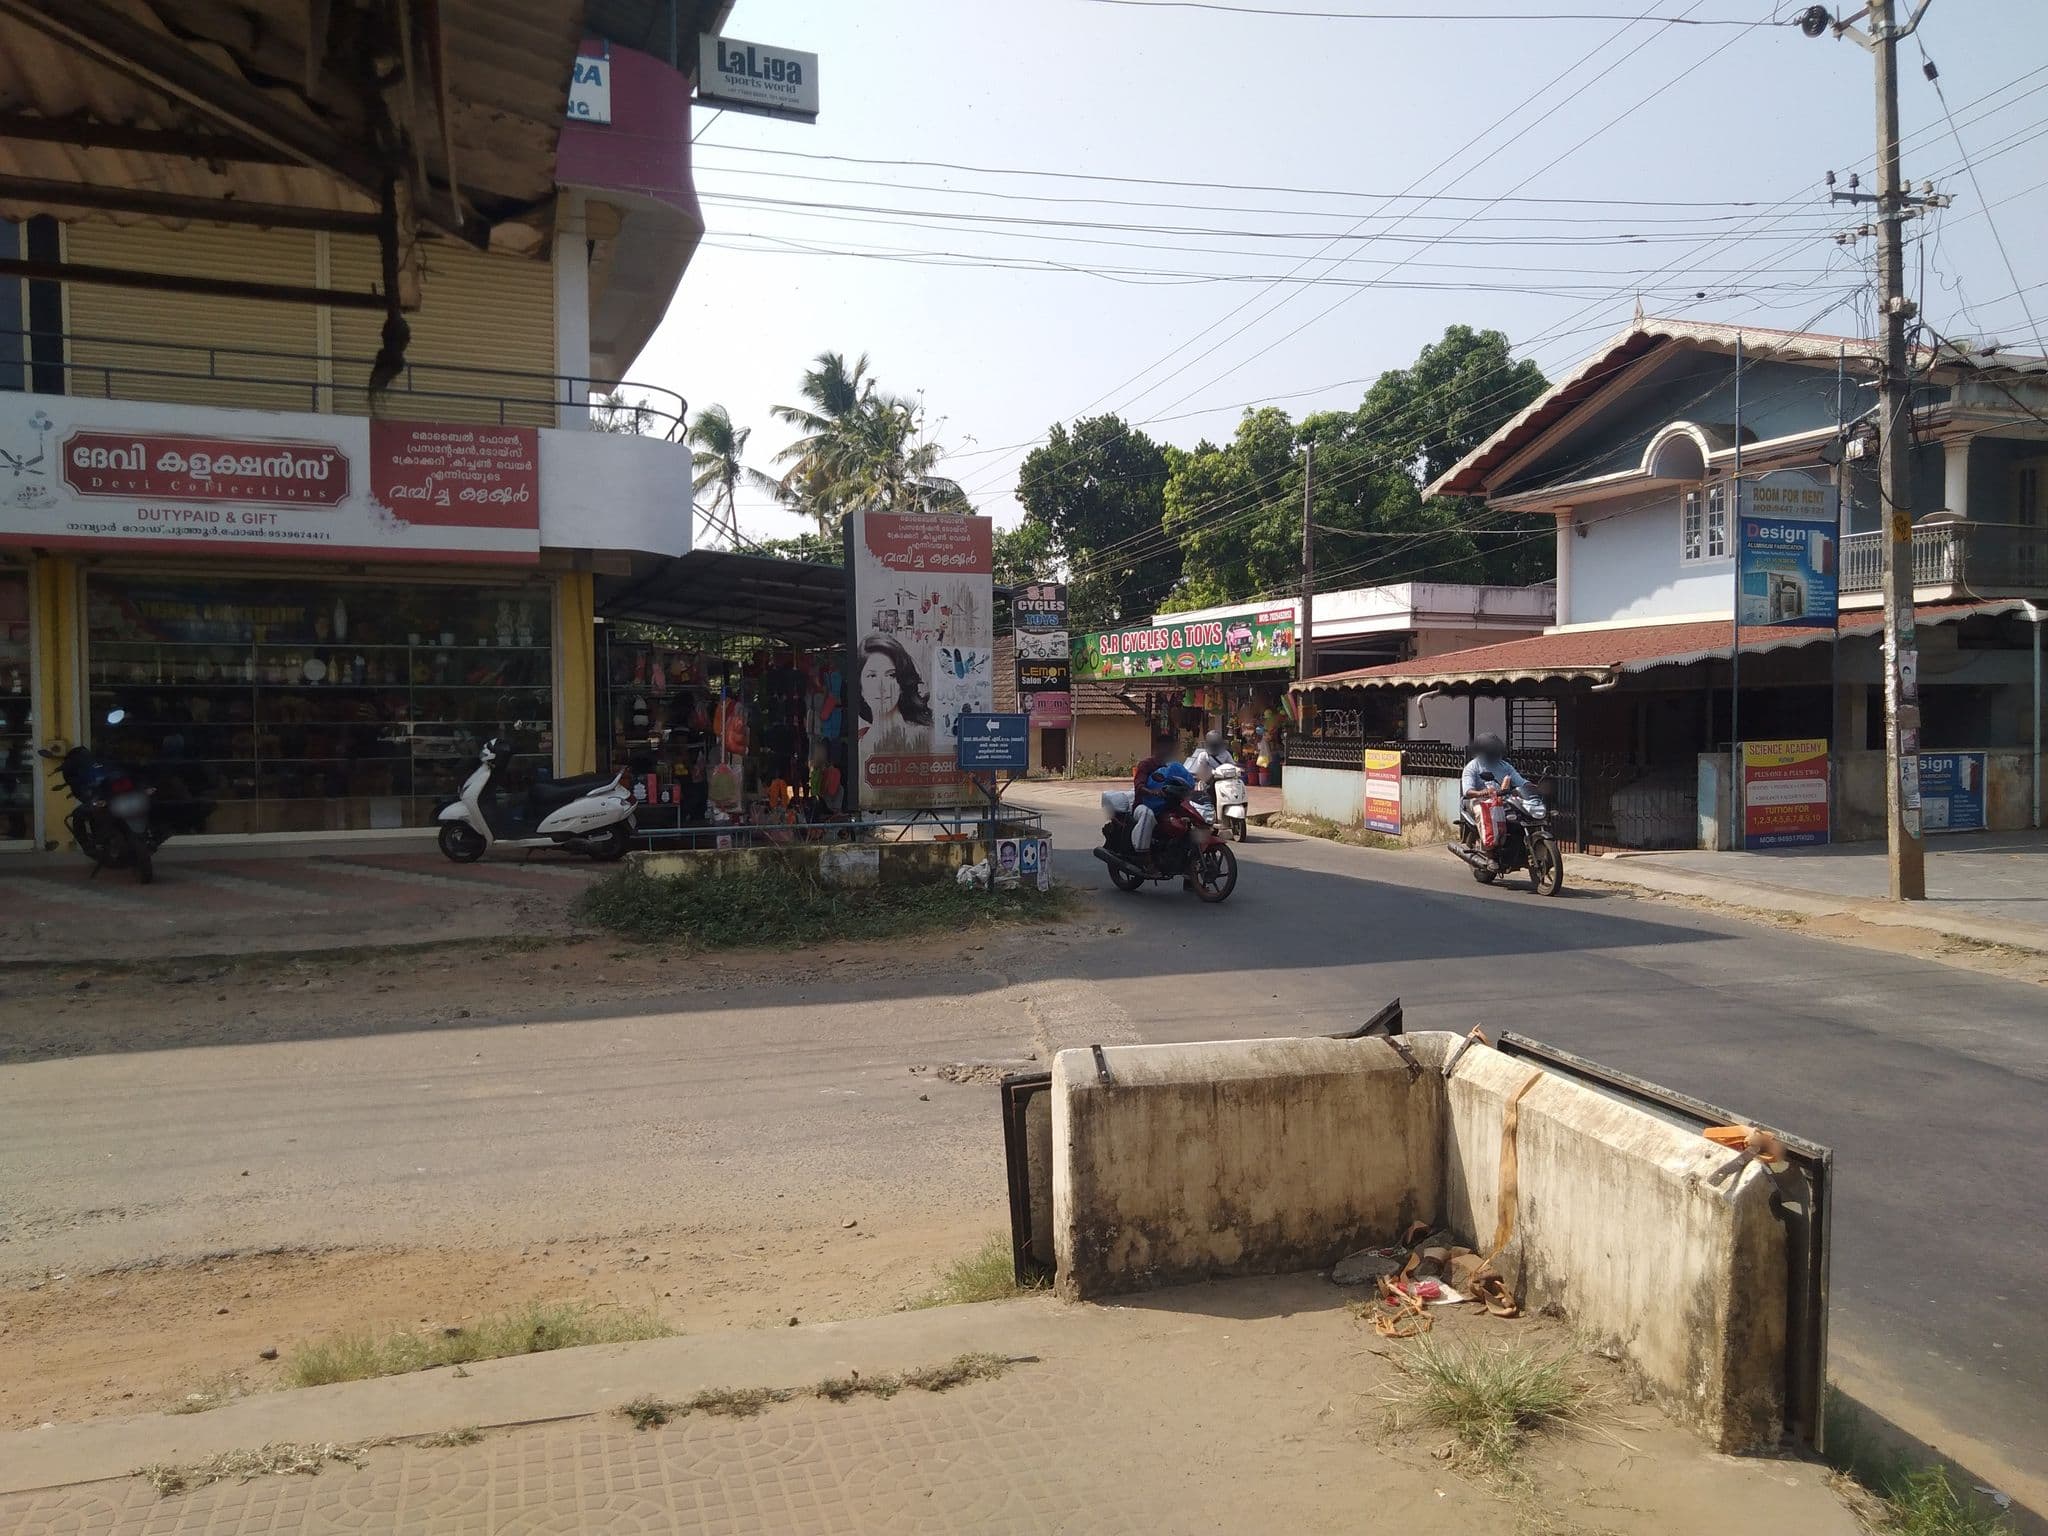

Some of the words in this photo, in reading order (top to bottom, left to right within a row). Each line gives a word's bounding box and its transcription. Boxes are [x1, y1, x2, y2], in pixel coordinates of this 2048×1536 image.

[717, 40, 802, 85] LaLiga
[725, 73, 761, 89] sports
[763, 80, 796, 94] world
[73, 442, 146, 471] ദേവി
[157, 452, 334, 481] കളക്ഷൻസ്
[91, 477, 150, 489] Devi
[170, 480, 327, 497] Collections
[1753, 487, 1780, 502] ROOM
[1782, 488, 1800, 503] FOR
[1802, 489, 1825, 504] RENT
[138, 508, 220, 523] DUTYPAID
[225, 511, 237, 524] &
[241, 512, 278, 525] GIFT
[1747, 523, 1807, 543] Design
[1017, 600, 1066, 611] CYCLES
[1024, 613, 1059, 626] TOYS
[1100, 634, 1119, 655] S.R
[1121, 628, 1168, 653] CYCLES
[1171, 630, 1182, 649] &
[1184, 621, 1222, 647] TOYS
[1021, 676, 1042, 685] Salon
[1749, 744, 1782, 756] SCIENCE
[1785, 742, 1822, 755] ACADEMY
[1920, 756, 1953, 772] sign
[1794, 805, 1810, 813] FOR
